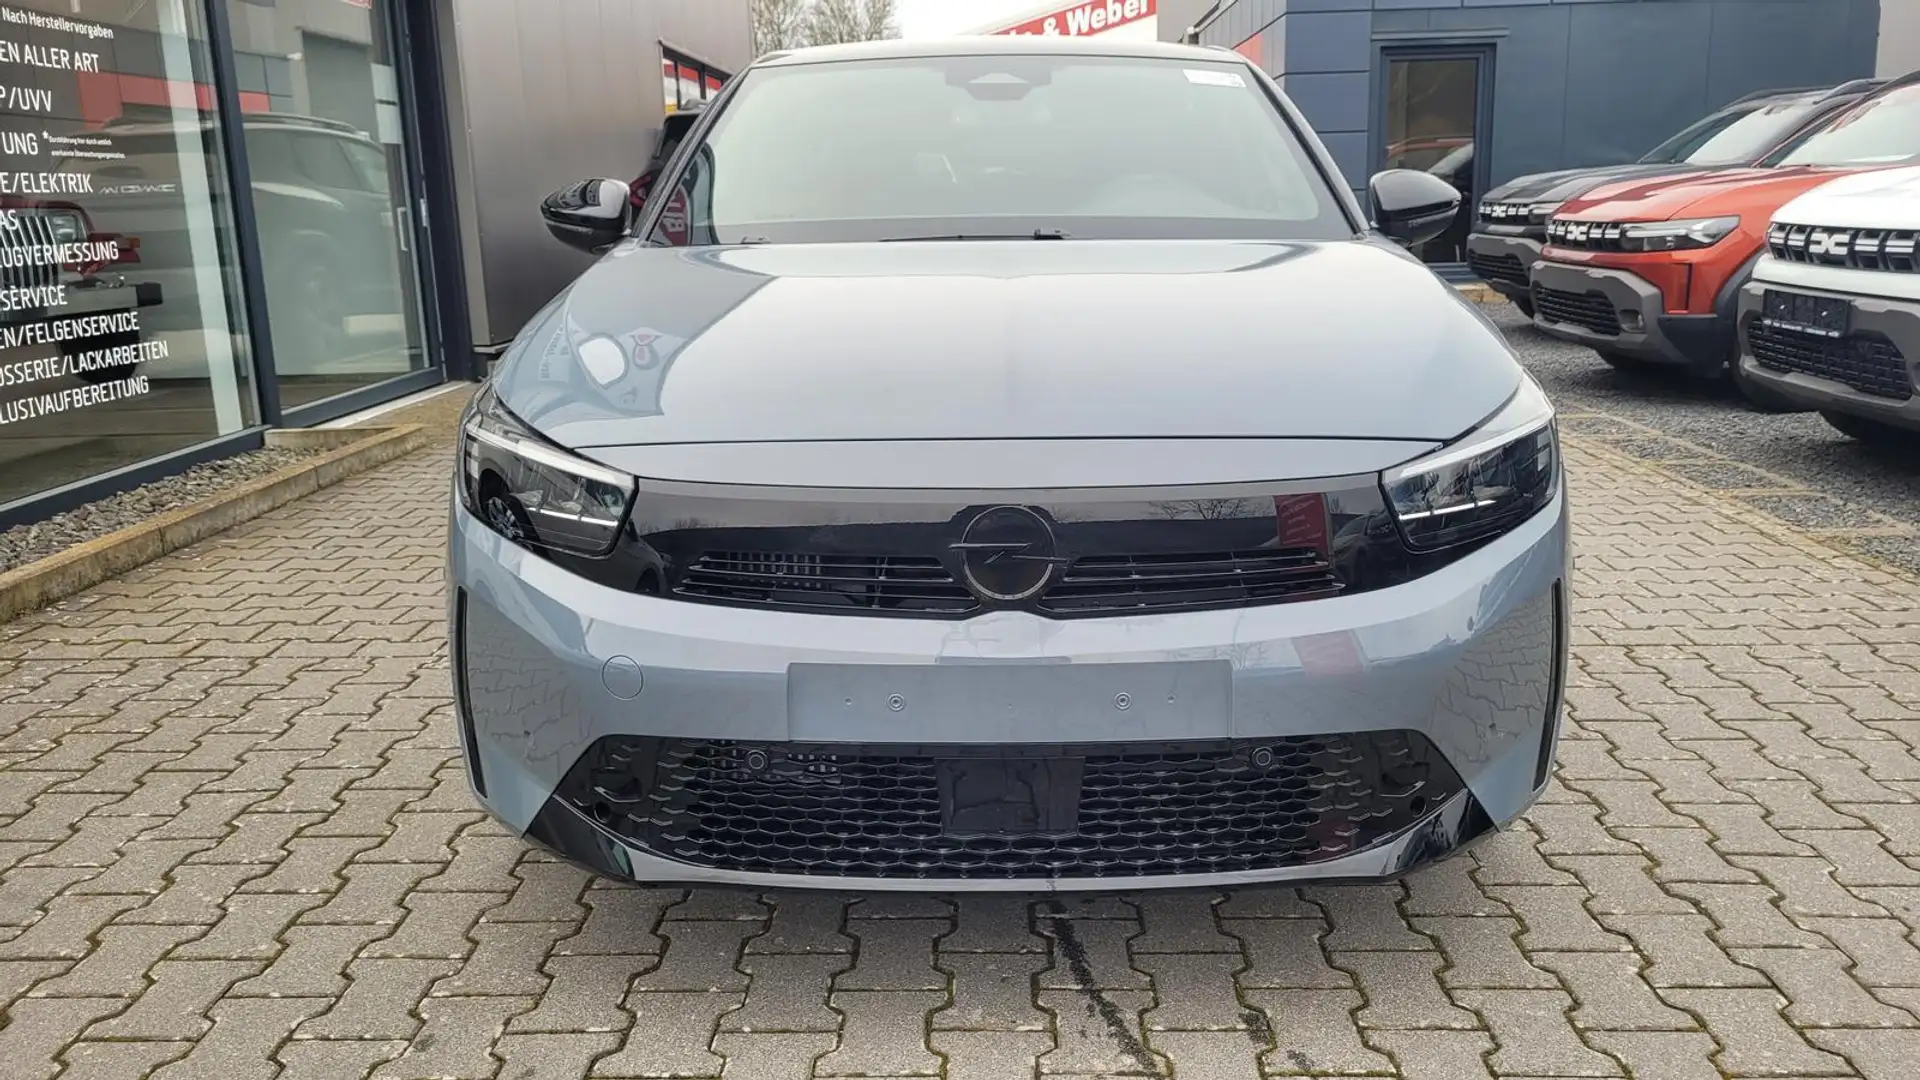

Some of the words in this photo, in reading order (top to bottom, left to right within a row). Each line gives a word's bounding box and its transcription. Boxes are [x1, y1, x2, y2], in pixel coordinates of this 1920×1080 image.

[2, 6, 28, 25] Nach
[28, 11, 113, 39] Herstellervorgaben
[1065, 0, 1149, 36] Weber
[0, 40, 20, 63] EN
[24, 44, 70, 69] ALLER
[74, 51, 99, 73] ART
[2, 131, 38, 155] UNG
[0, 172, 93, 193] E/ELEKTRIK
[0, 241, 119, 268] UGVERMESSUNG
